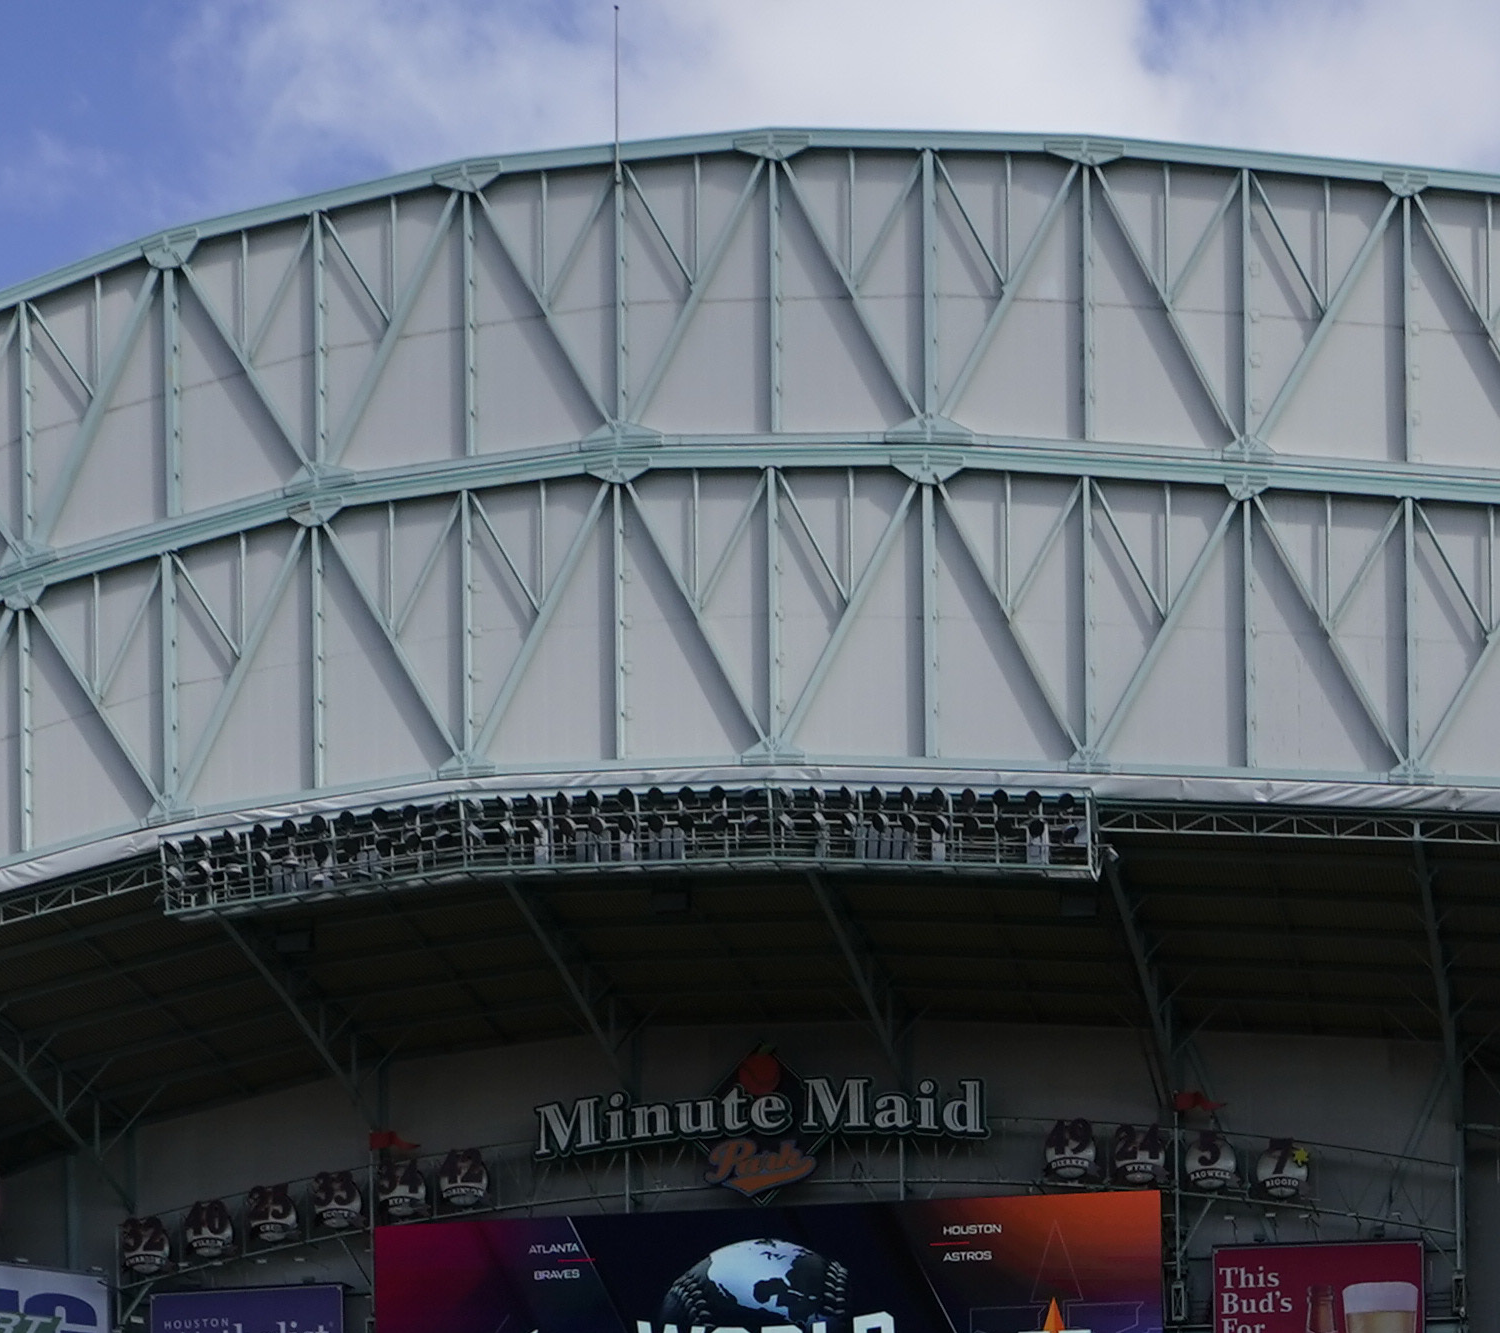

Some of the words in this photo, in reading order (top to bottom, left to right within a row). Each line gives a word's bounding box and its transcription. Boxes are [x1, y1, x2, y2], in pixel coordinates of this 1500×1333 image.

[534, 1085, 791, 1160] Minute
[802, 1076, 991, 1140] Maid
[705, 1138, 817, 1184] Park
[943, 1223, 1002, 1236] HOUSTON
[528, 1242, 580, 1255] ATLANTA
[943, 1250, 992, 1262] ASTROS
[534, 1269, 580, 1281] BRAVES
[1219, 1266, 1280, 1289] This
[1220, 1291, 1293, 1315] Bud's
[164, 1317, 229, 1329] HOUSTON
